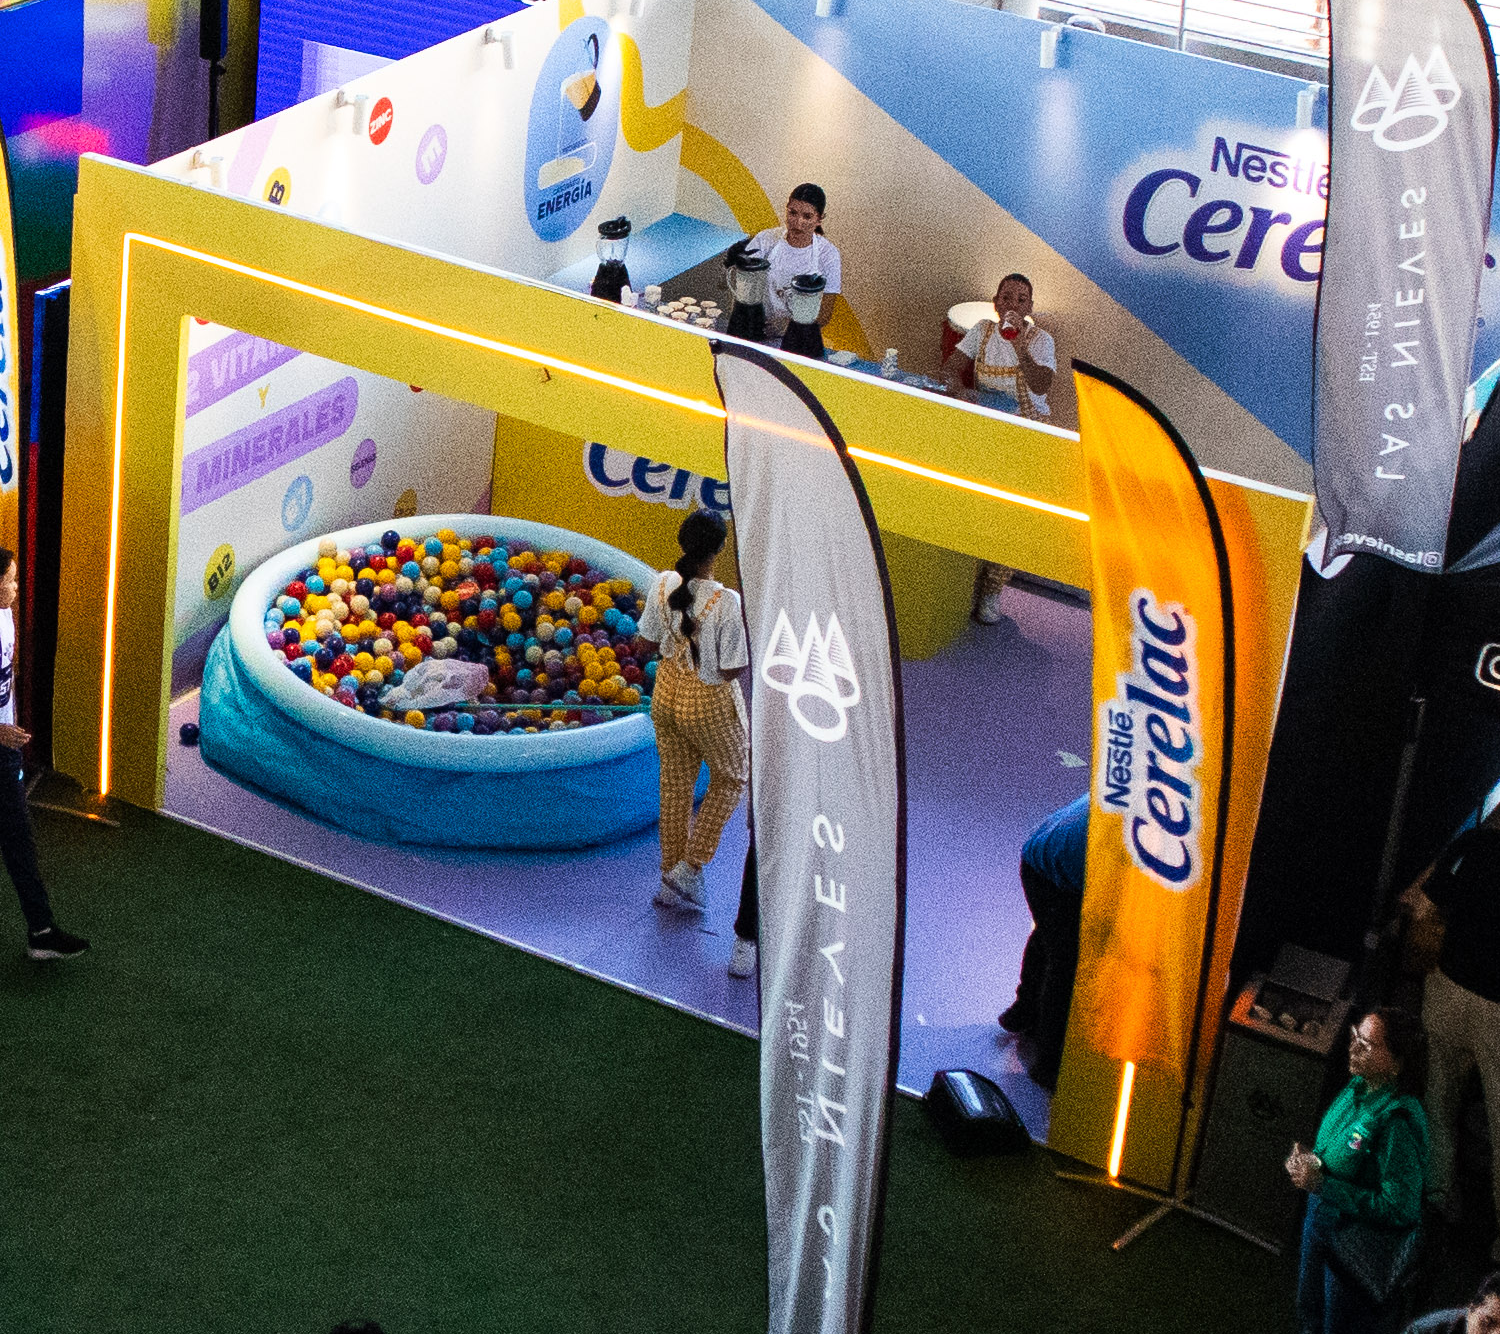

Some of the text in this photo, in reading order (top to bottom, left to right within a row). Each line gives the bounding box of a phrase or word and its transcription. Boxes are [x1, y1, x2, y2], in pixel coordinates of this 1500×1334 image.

[369, 107, 393, 135] ZINC
[537, 178, 592, 220] ENERGÍA
[1123, 168, 1328, 283] Cere
[196, 394, 347, 494] MINERALES
[589, 442, 733, 511] Cere
[208, 553, 233, 593] B12
[1104, 708, 1134, 808] Nestlé
[1130, 597, 1194, 883] Cerelac
